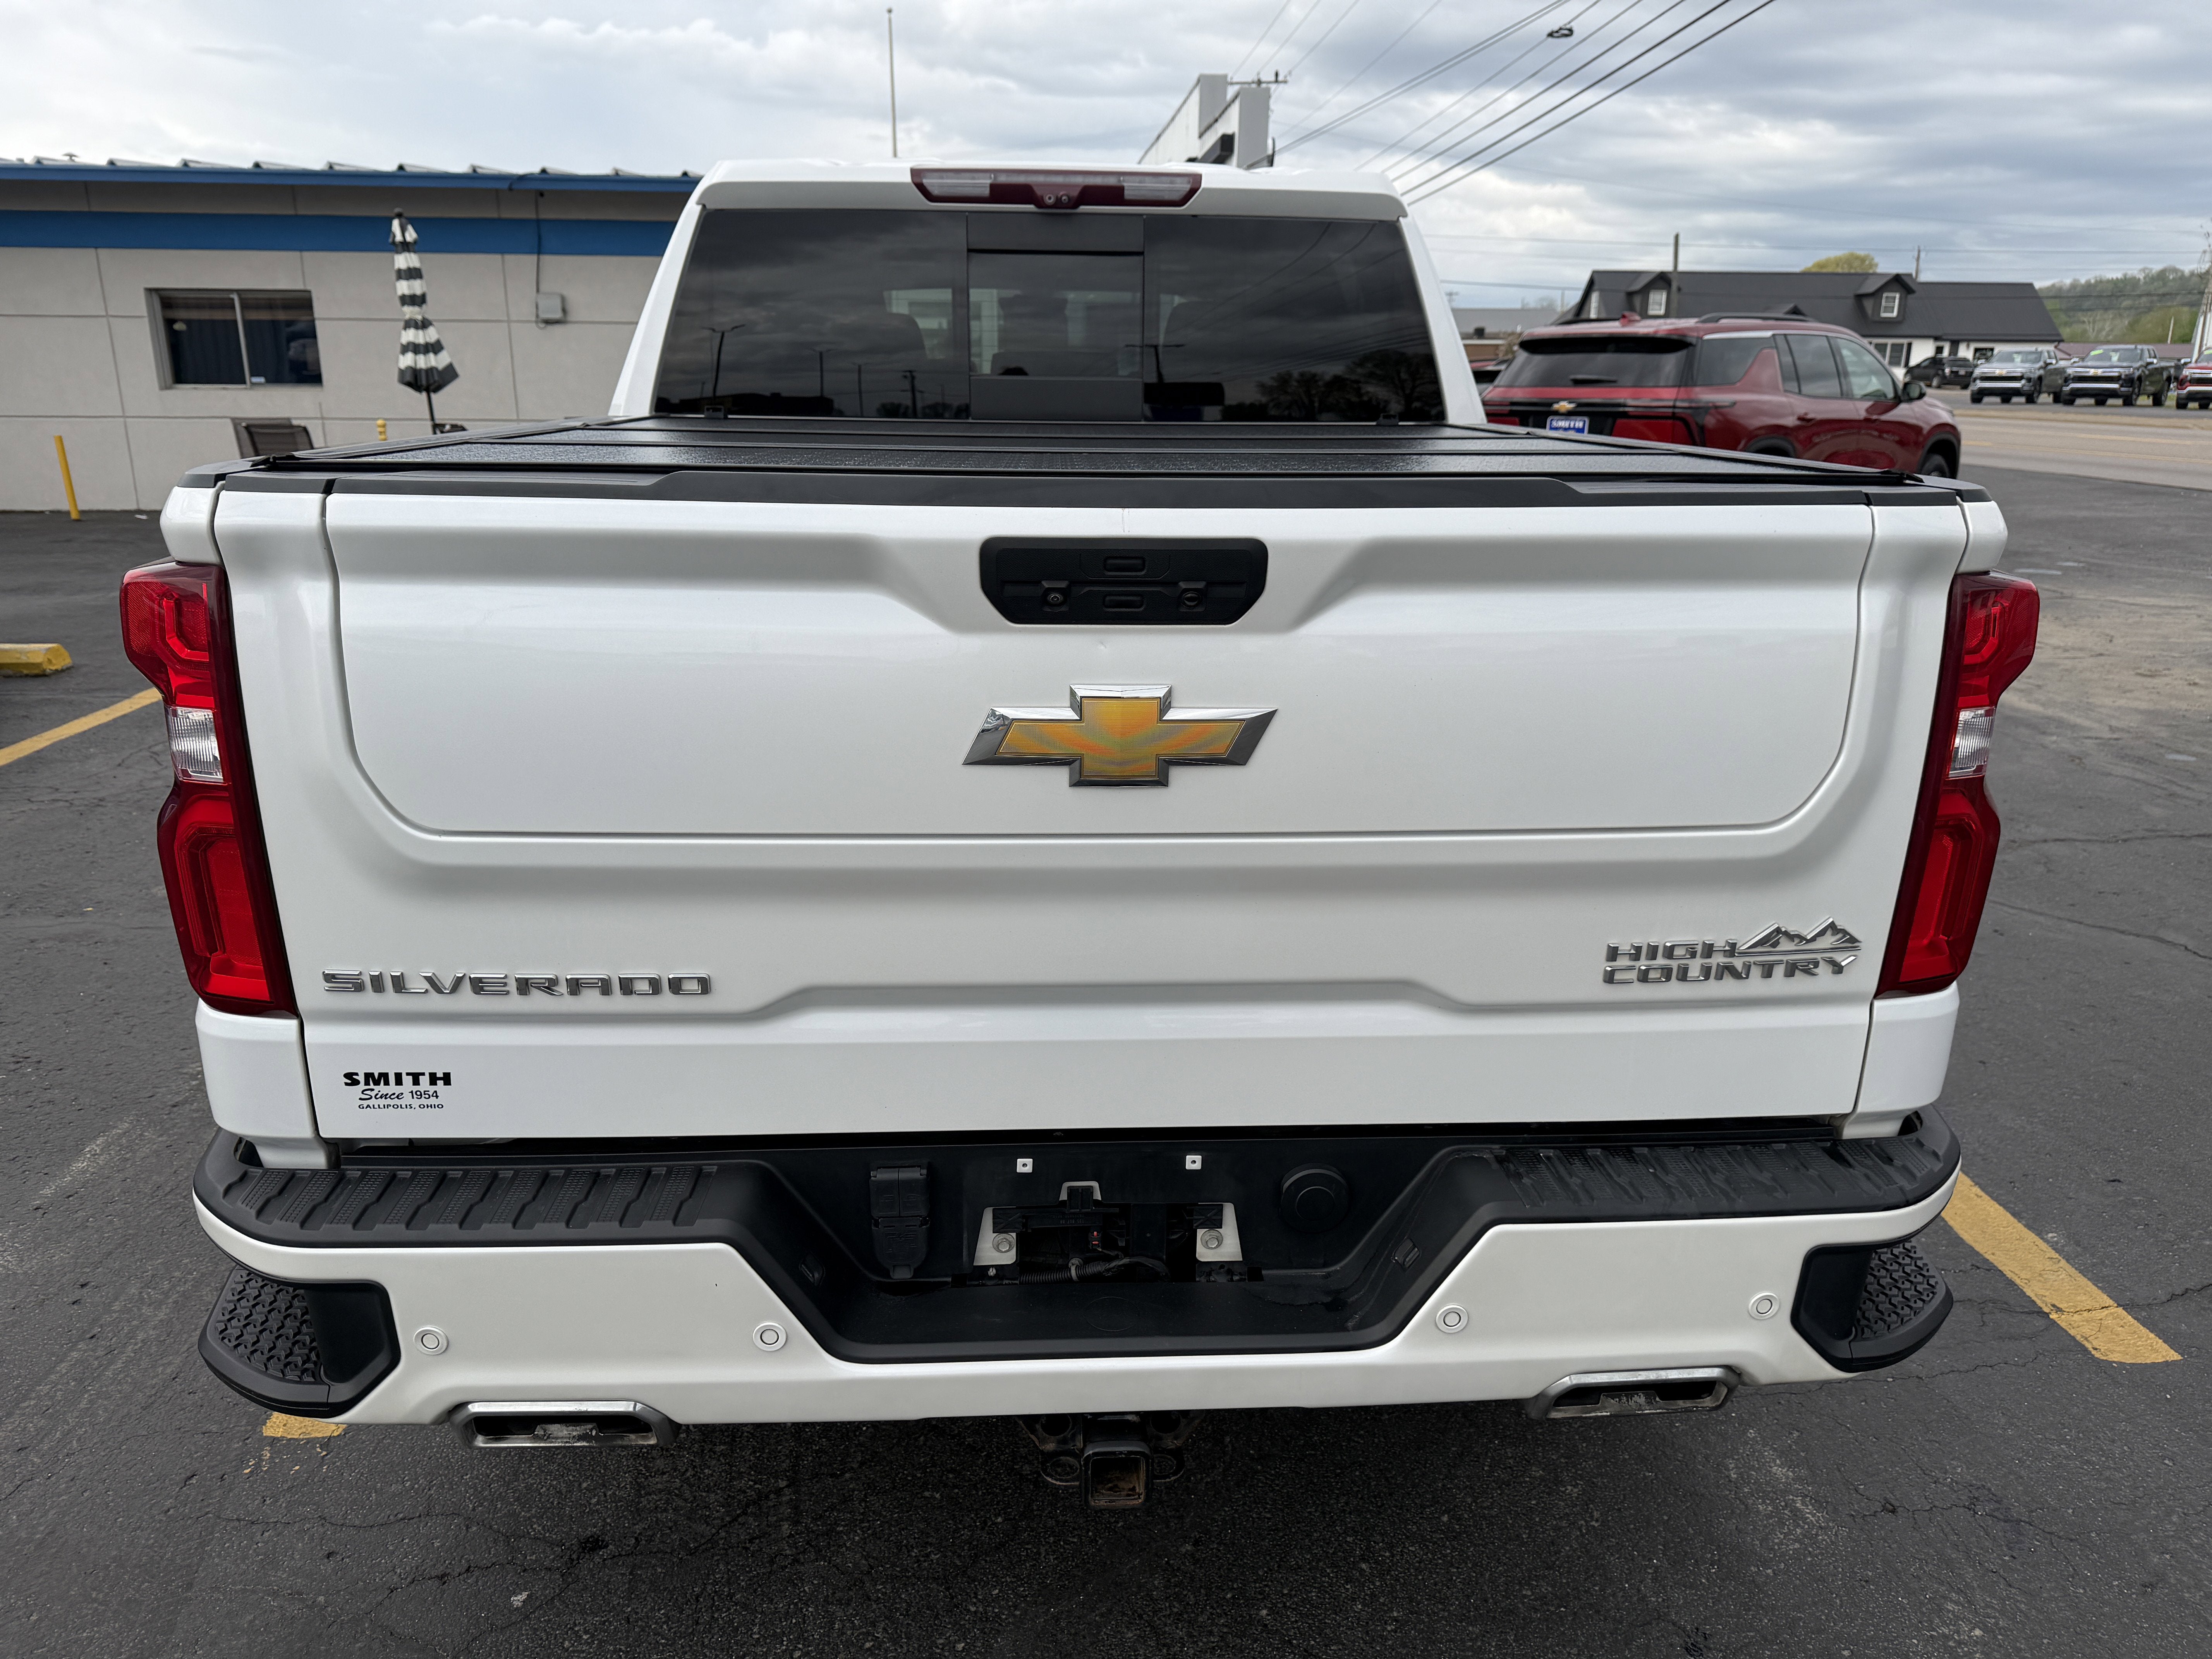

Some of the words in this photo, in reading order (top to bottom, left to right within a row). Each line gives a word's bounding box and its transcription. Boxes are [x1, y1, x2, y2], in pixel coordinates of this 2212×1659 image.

[1606, 939, 1738, 962] HIGH
[1603, 955, 1857, 984] COUNTRY
[322, 969, 711, 996] SILVERADO
[343, 1072, 452, 1086] SMITH
[358, 1088, 404, 1101] Since
[409, 1090, 439, 1099] 1954
